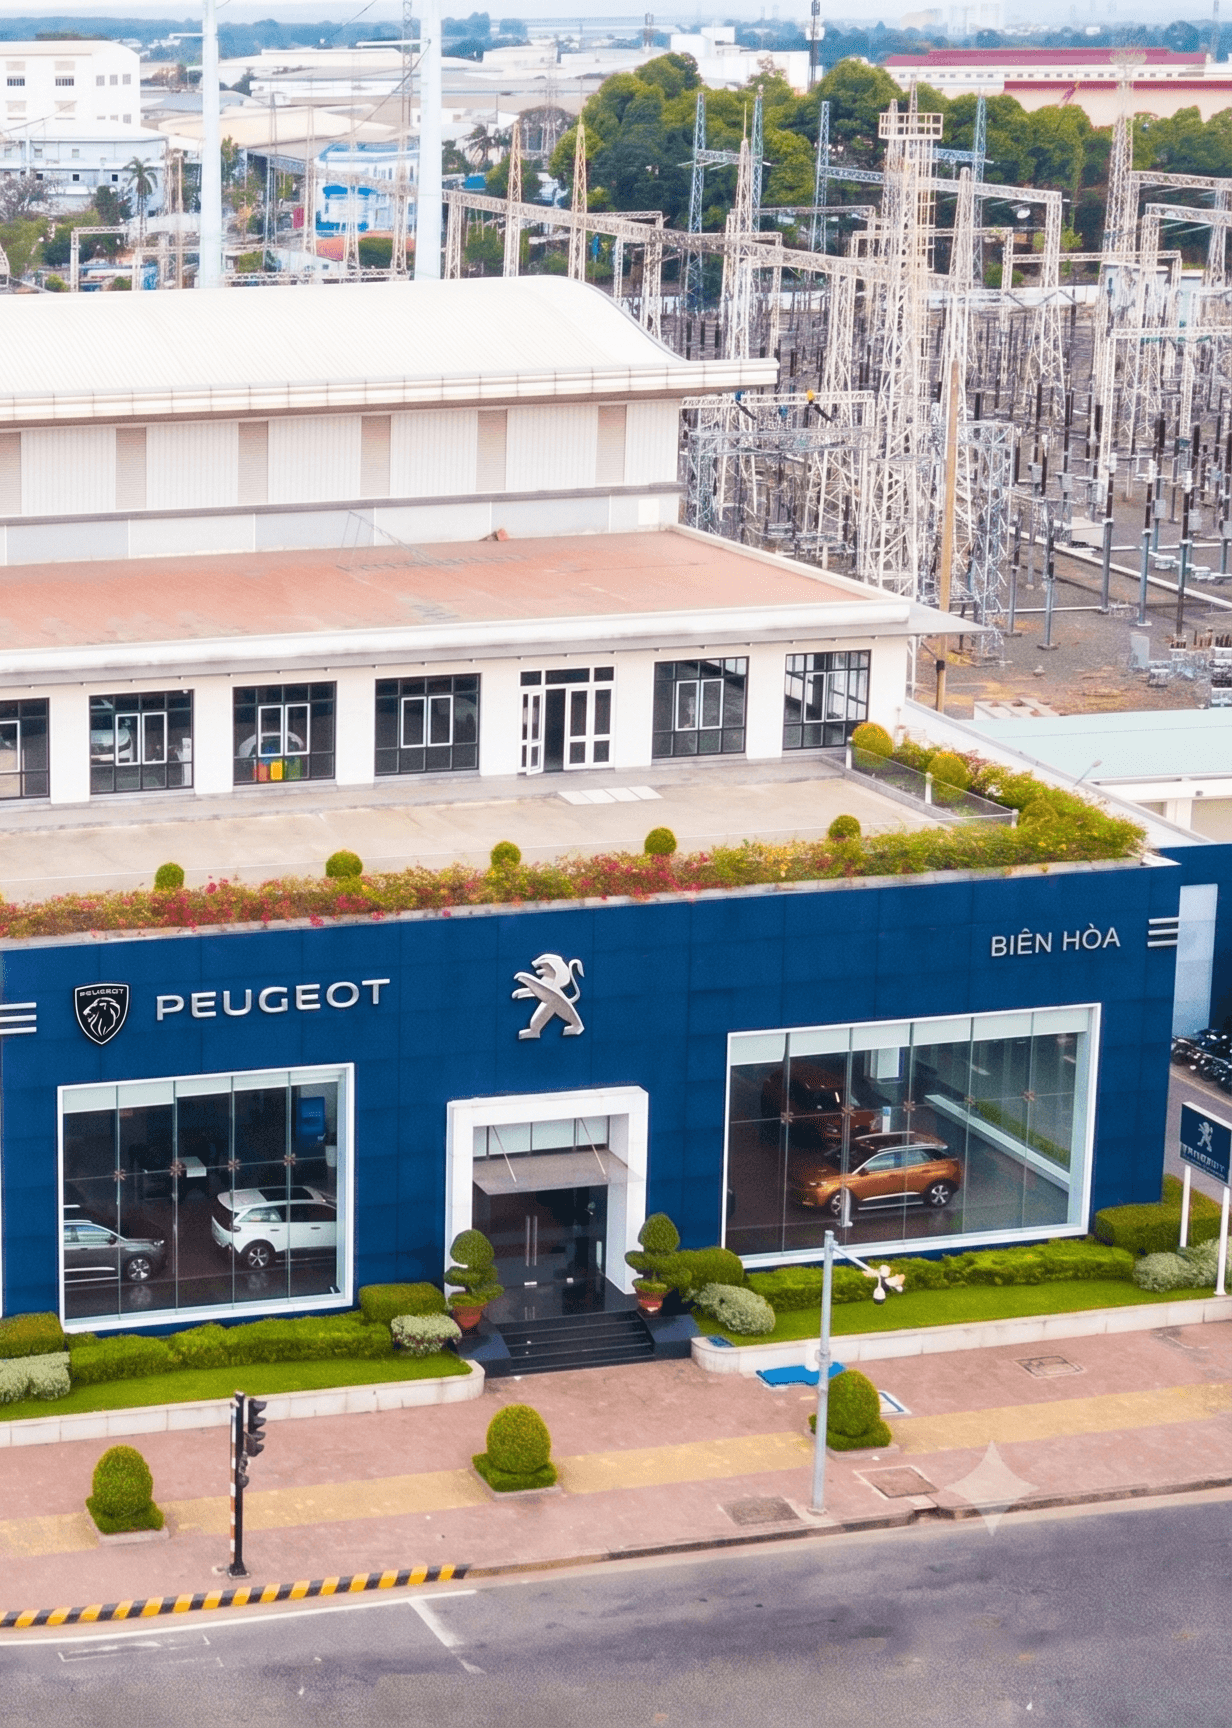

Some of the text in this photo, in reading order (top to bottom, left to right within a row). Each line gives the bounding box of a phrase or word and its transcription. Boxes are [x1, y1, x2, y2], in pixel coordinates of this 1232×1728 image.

[991, 923, 1121, 957] BIÊN HÒA
[157, 979, 391, 1020] PEUGEOT
